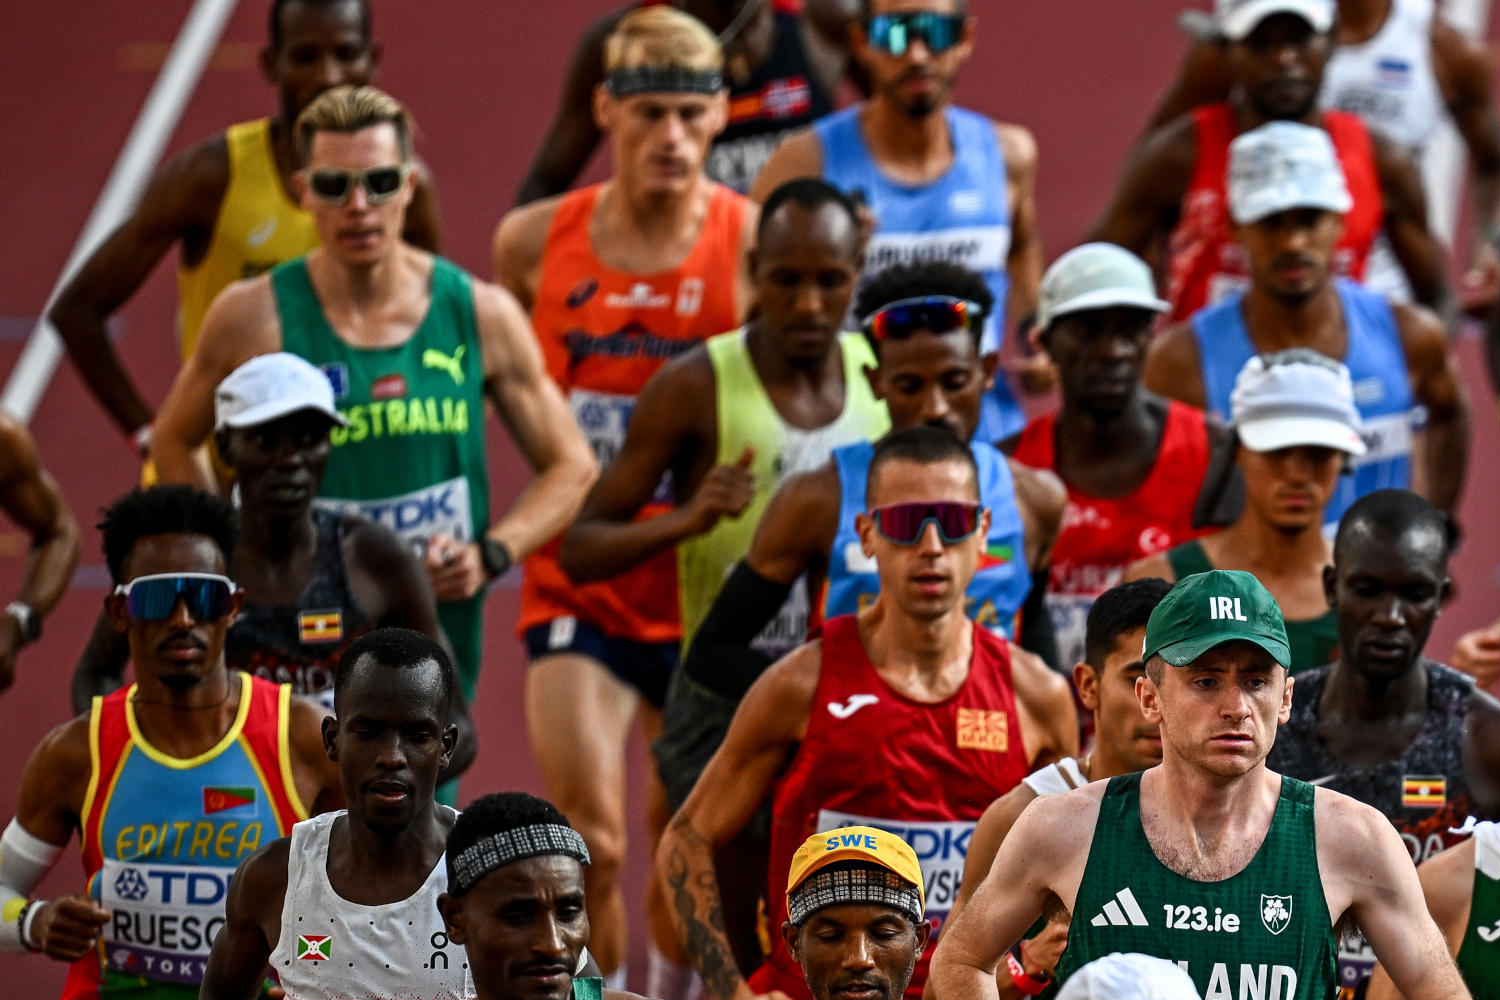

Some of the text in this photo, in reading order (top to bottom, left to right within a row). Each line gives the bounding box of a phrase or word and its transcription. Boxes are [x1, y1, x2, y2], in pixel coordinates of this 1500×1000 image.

[330, 397, 469, 446] USTRALIA
[1209, 596, 1247, 621] IRL
[116, 822, 263, 860] ERITREA
[826, 834, 878, 851] SWE
[888, 827, 966, 861] DK
[148, 871, 229, 906] TD
[1163, 904, 1241, 933] 123.ie
[143, 954, 205, 978] TOK
